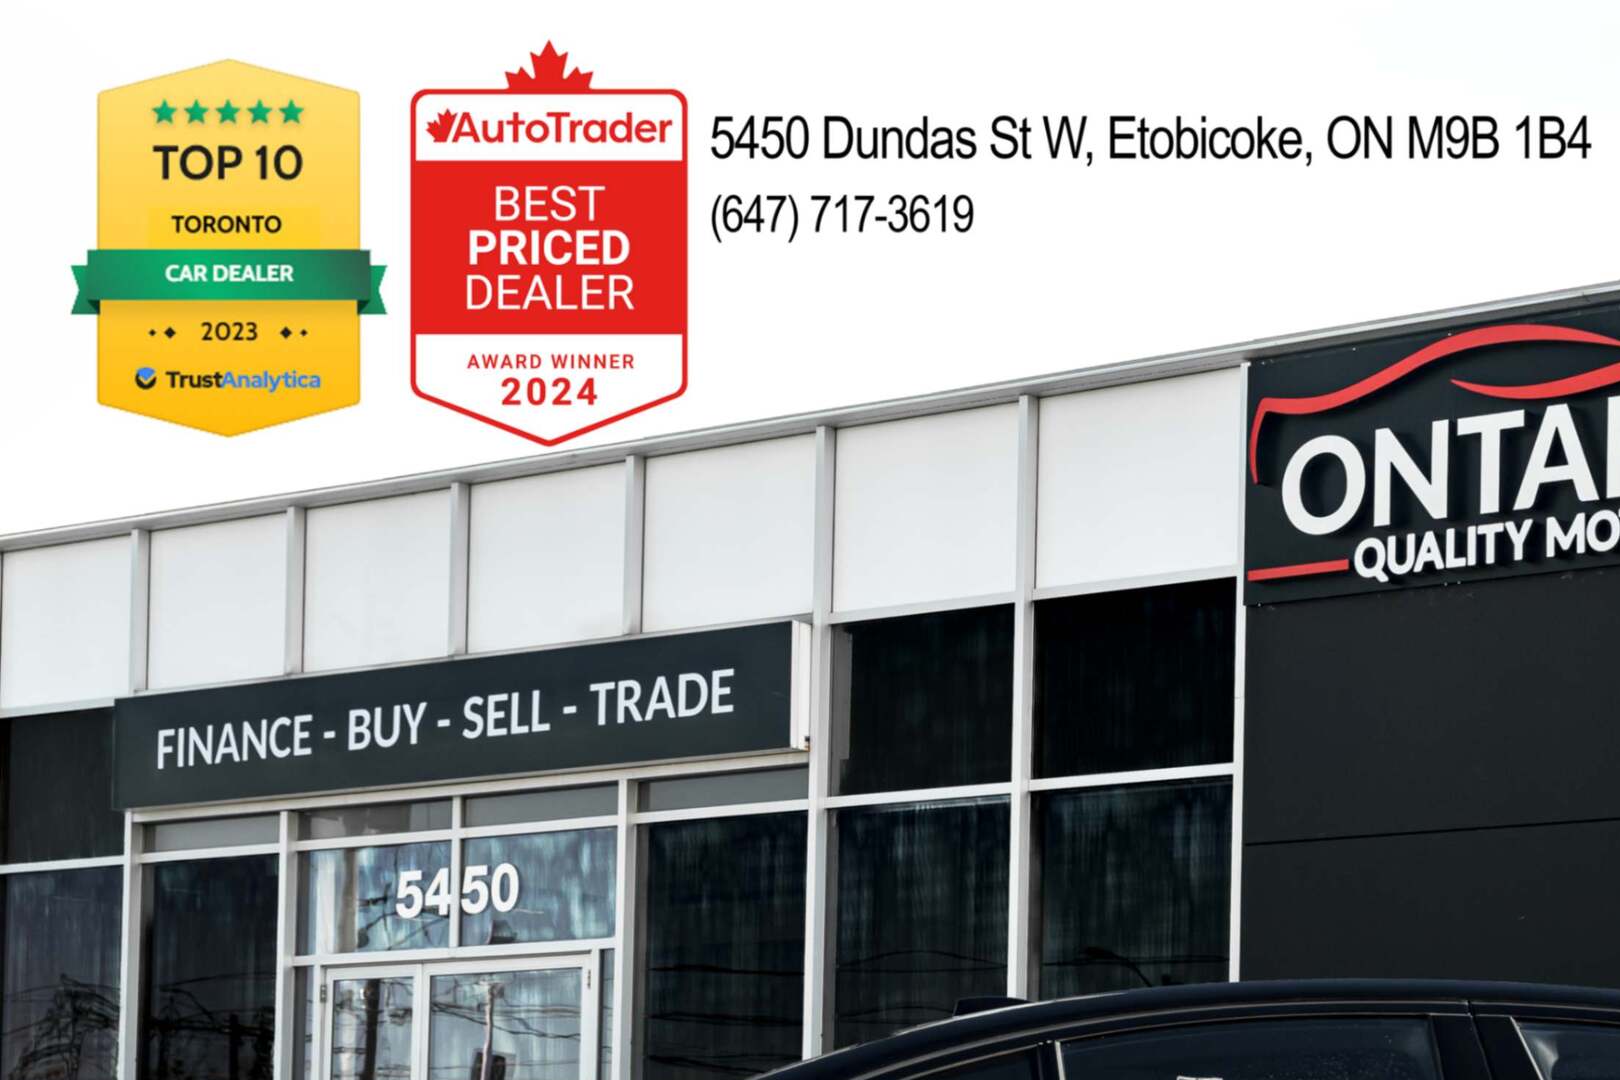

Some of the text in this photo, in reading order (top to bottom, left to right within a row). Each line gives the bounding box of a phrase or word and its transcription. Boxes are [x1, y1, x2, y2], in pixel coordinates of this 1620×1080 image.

[1355, 519, 1532, 582] QUALITY
[158, 715, 312, 769] FINANCE
[348, 702, 427, 750] BUY
[463, 690, 550, 739] SELL
[590, 669, 734, 725] TRADE
[396, 862, 519, 920] 5450
